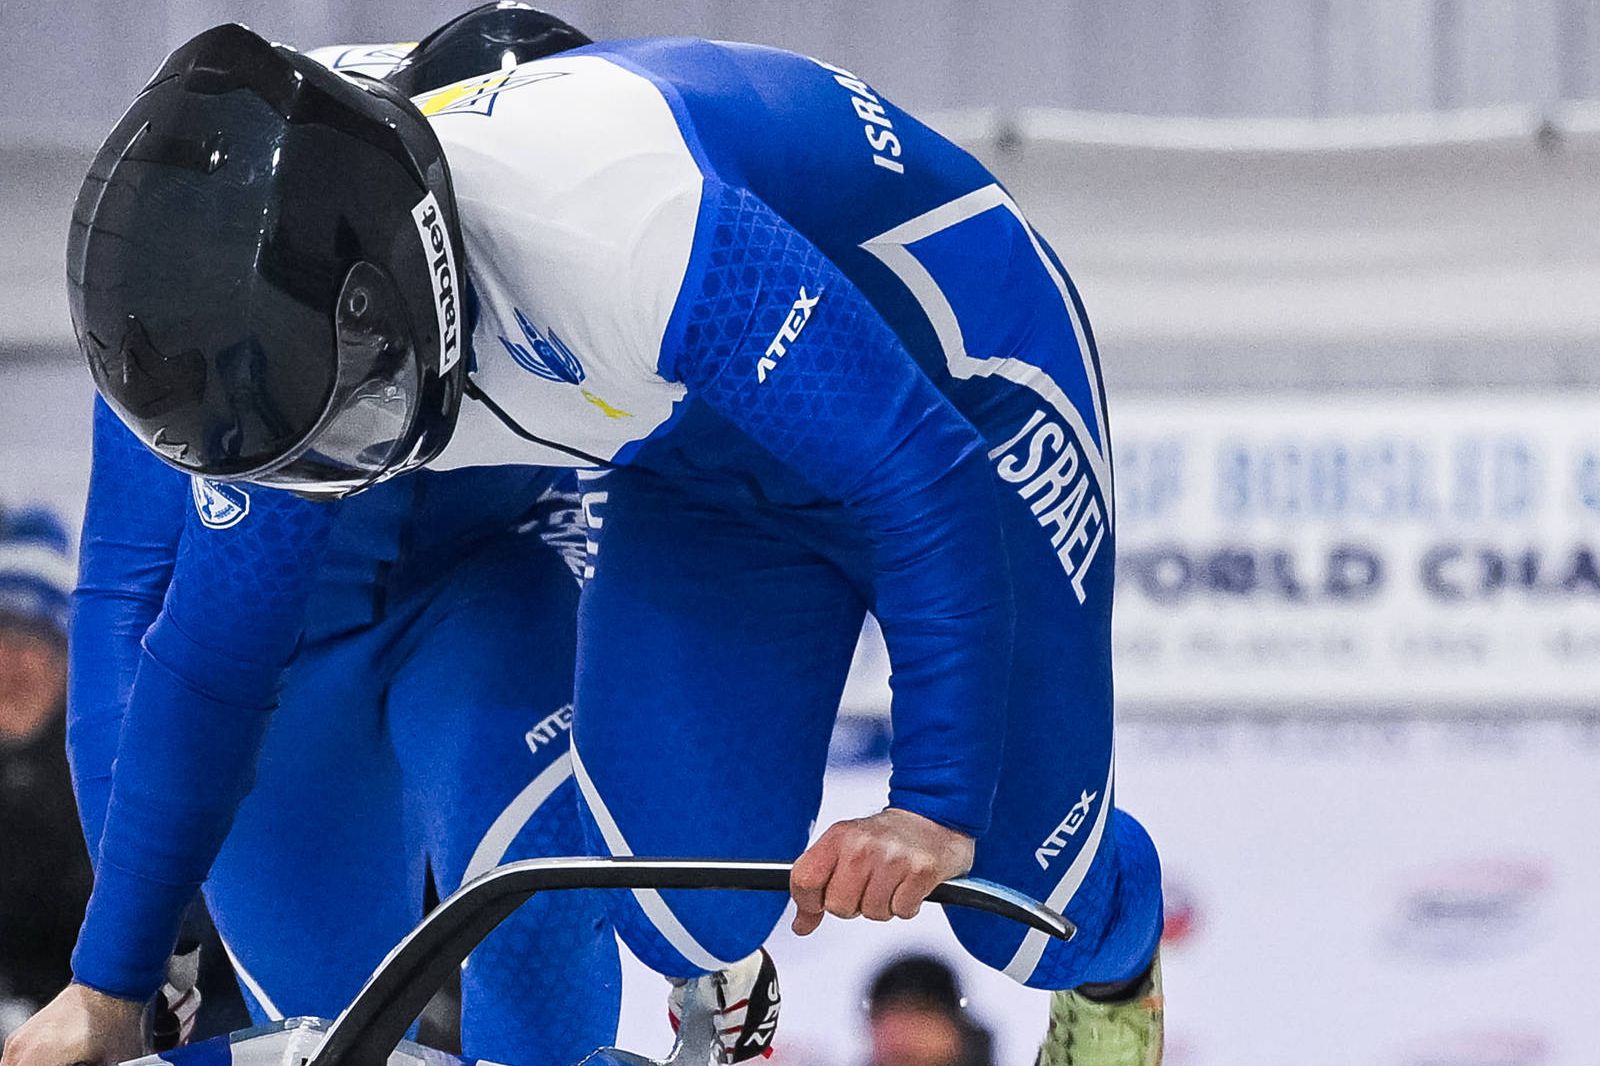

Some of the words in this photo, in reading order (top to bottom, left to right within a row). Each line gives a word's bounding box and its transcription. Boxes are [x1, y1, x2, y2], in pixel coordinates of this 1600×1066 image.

[421, 204, 457, 366] Tablet
[755, 285, 821, 384] ATEX
[988, 409, 1105, 606] ISRAEL
[1034, 788, 1098, 871] ATEX
